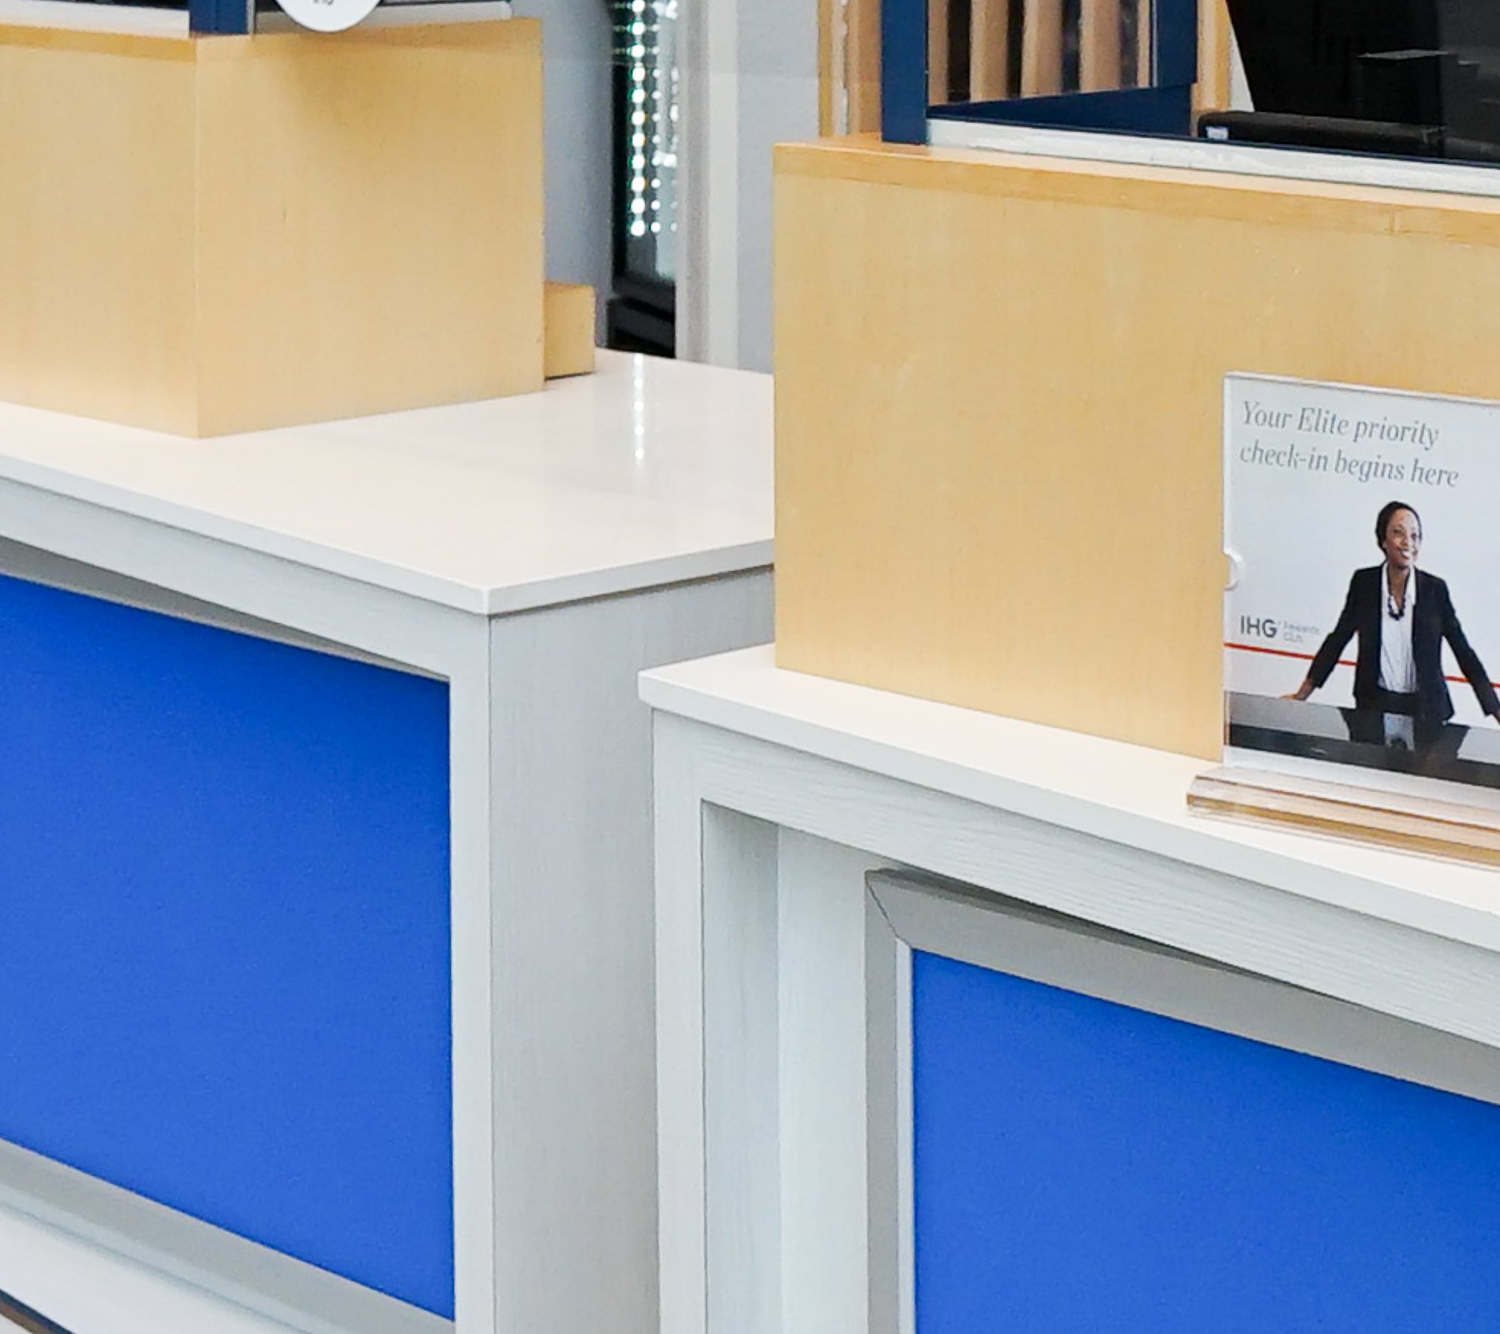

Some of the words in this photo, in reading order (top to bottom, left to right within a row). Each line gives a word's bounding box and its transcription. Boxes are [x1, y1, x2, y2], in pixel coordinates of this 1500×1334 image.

[1242, 400, 1293, 429] Your
[1297, 406, 1349, 435] Elite
[1352, 415, 1440, 452] priority
[1239, 439, 1329, 471] check-in
[1334, 449, 1405, 483] begins
[1410, 458, 1460, 488] here
[1240, 615, 1277, 638] IHG
